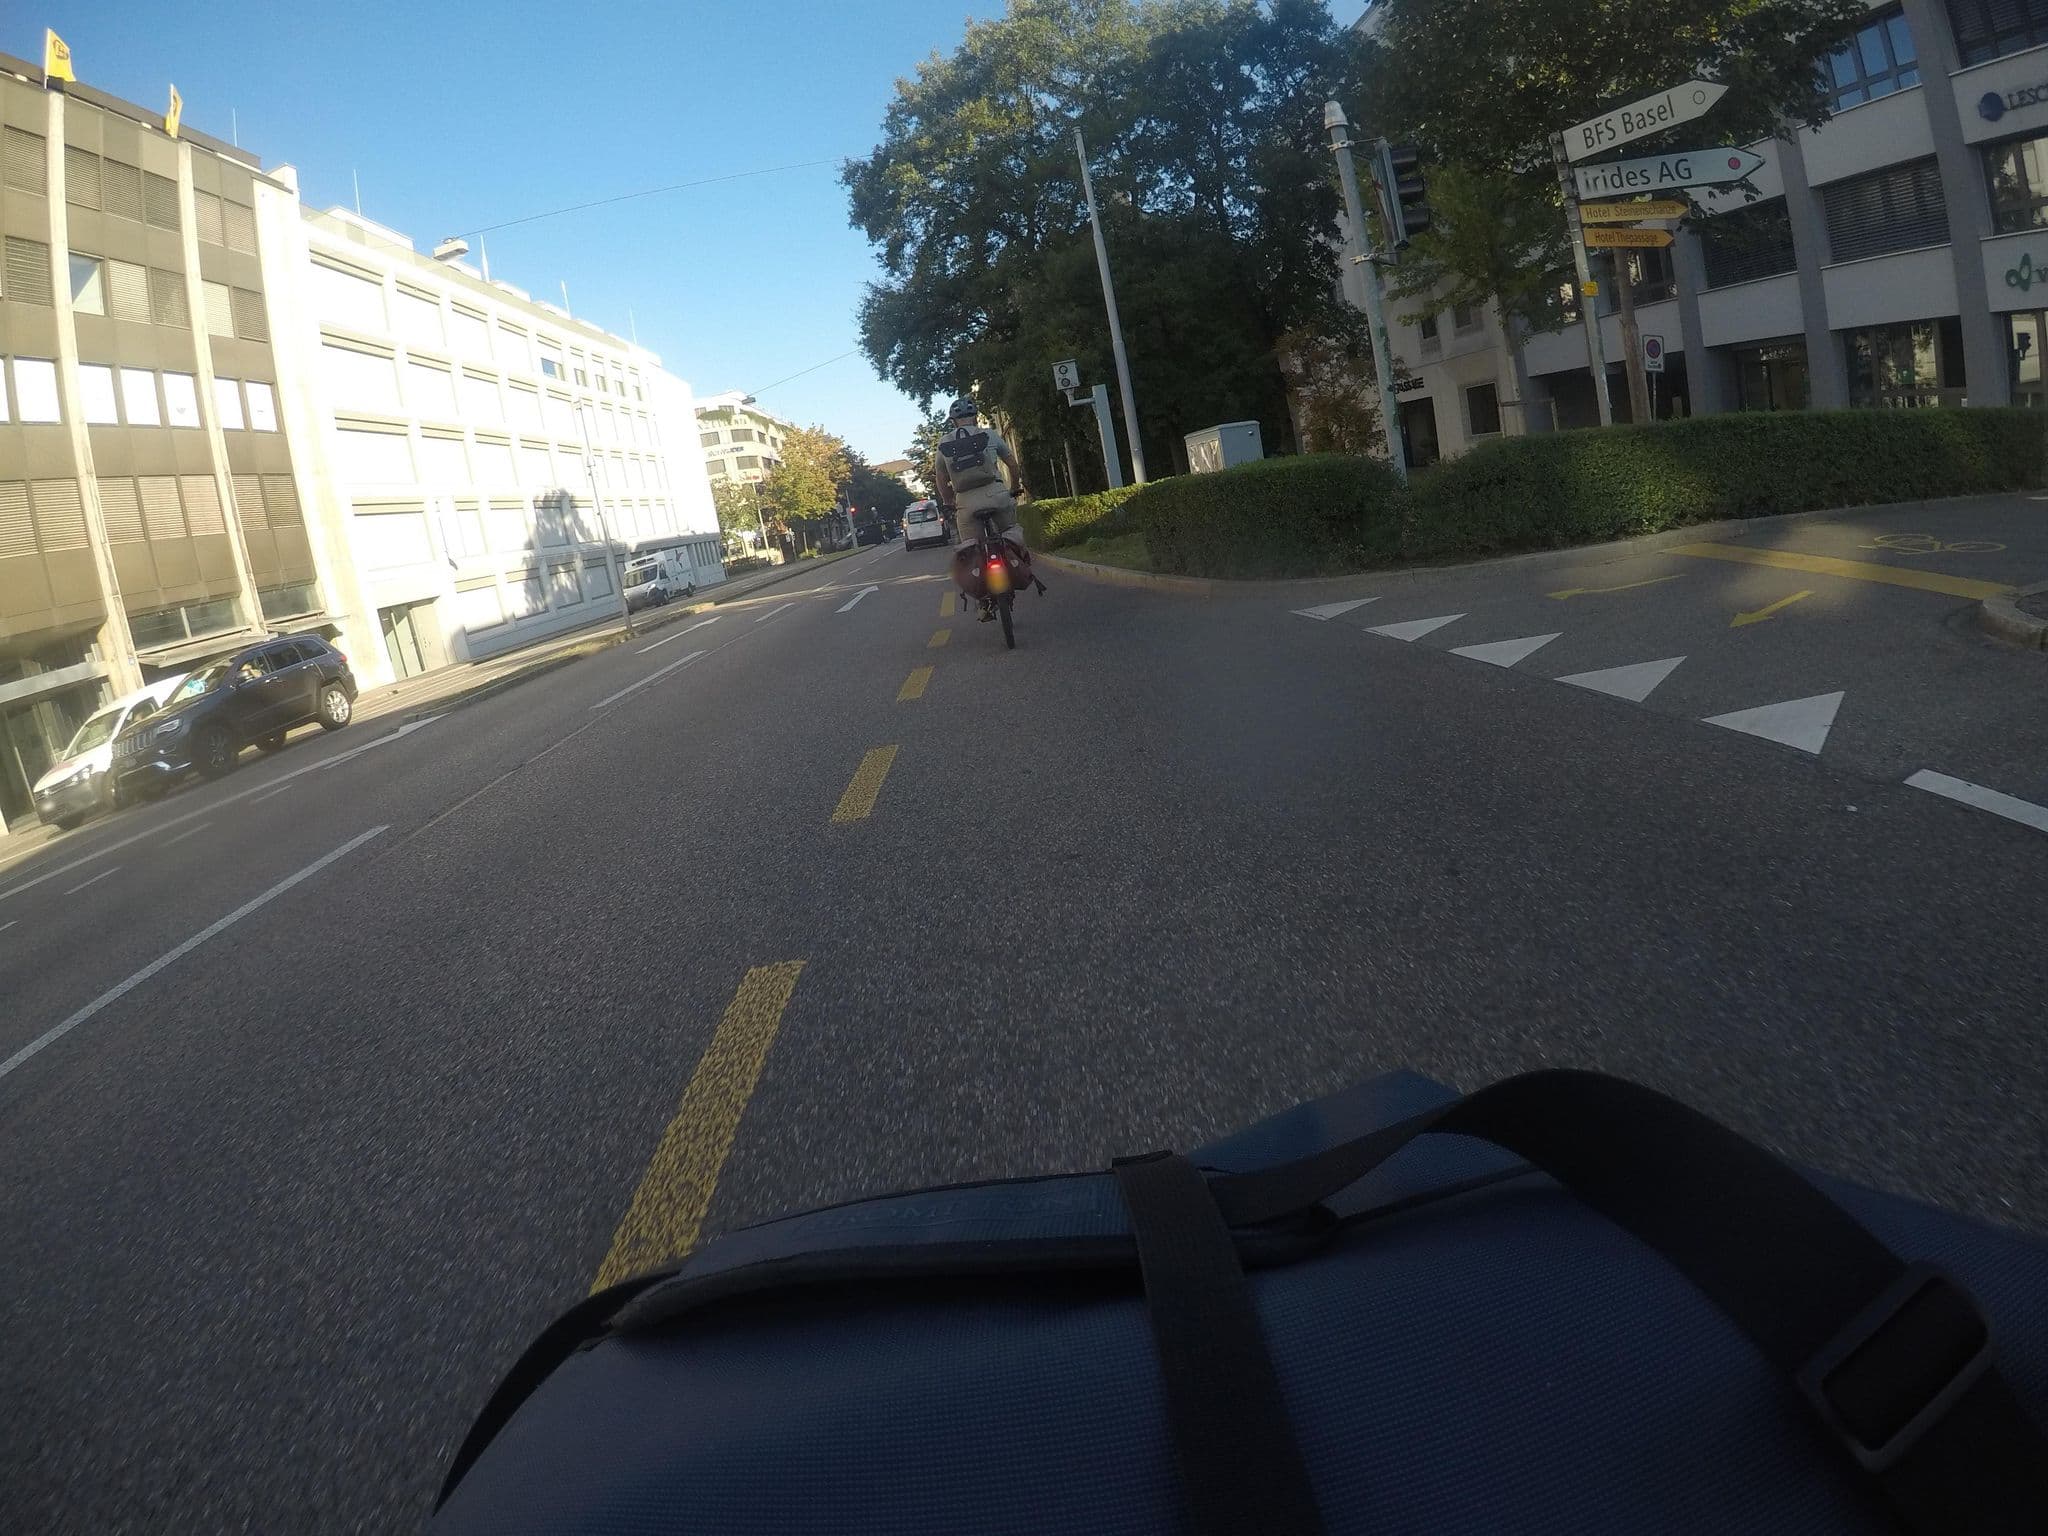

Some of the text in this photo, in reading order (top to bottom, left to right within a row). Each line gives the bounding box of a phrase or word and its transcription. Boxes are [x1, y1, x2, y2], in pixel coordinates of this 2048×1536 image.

[1583, 94, 1675, 149] BFS Basel
[1584, 158, 1693, 192] irides AG
[1585, 207, 1610, 219] Hotel
[1594, 231, 1615, 243] Hotel
